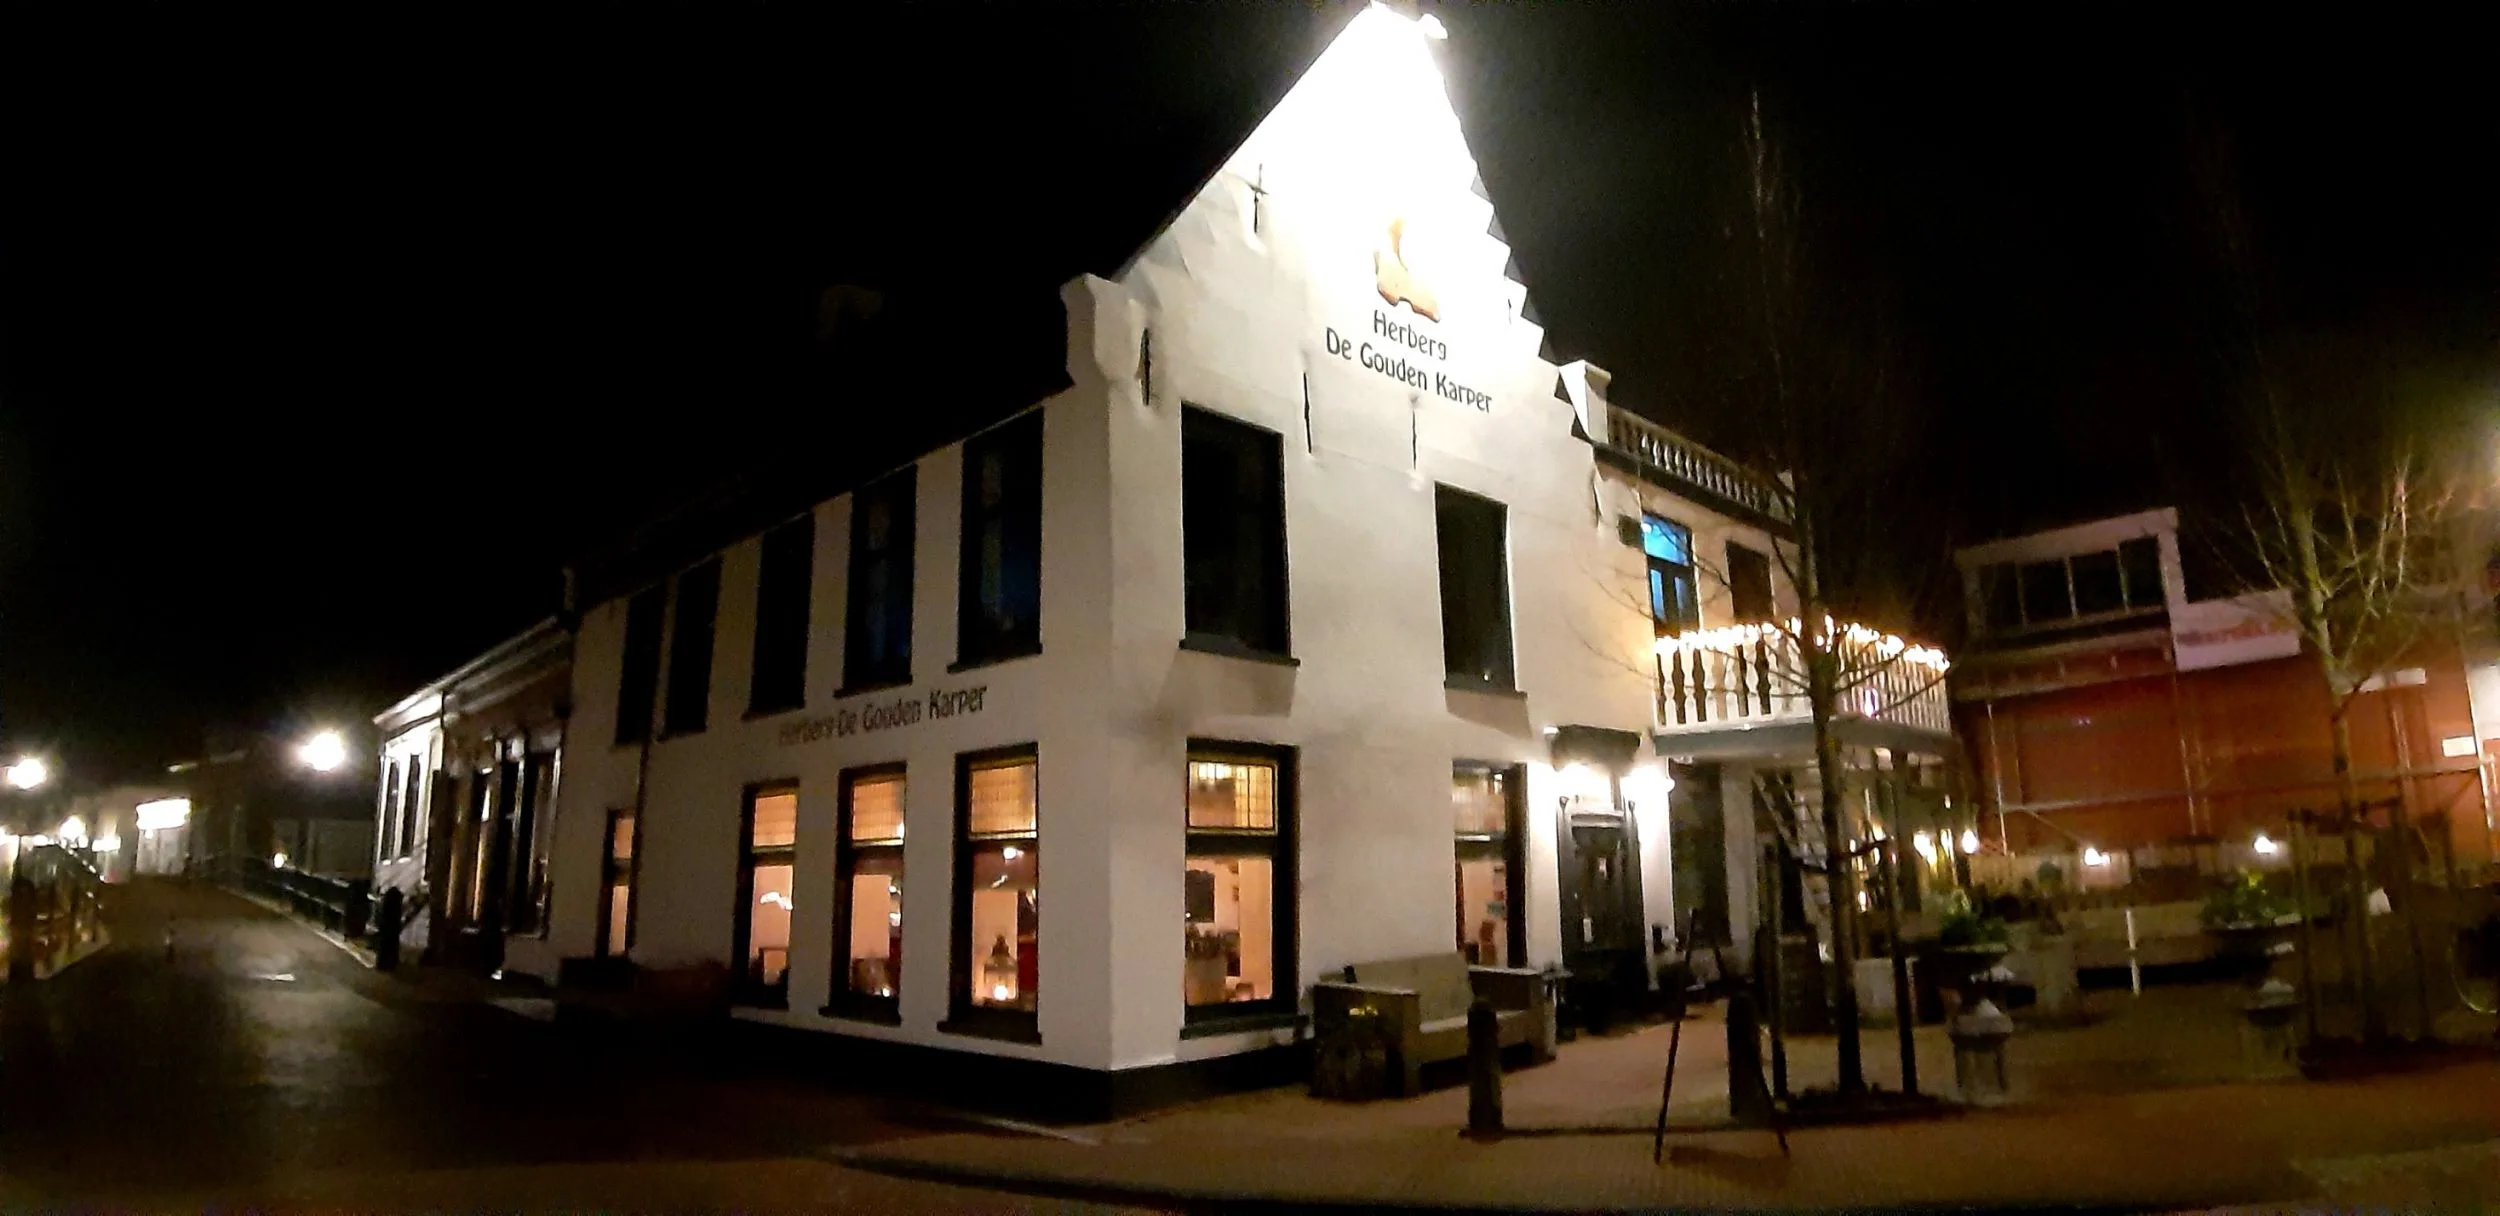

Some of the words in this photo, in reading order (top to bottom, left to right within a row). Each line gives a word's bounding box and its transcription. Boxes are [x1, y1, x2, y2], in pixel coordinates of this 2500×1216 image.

[1373, 309, 1447, 361] Herberg
[1326, 326, 1352, 361] De
[1360, 341, 1428, 391] Gouden
[1436, 371, 1493, 414] Karper
[862, 697, 921, 732] Gouden
[928, 685, 987, 719] Karper
